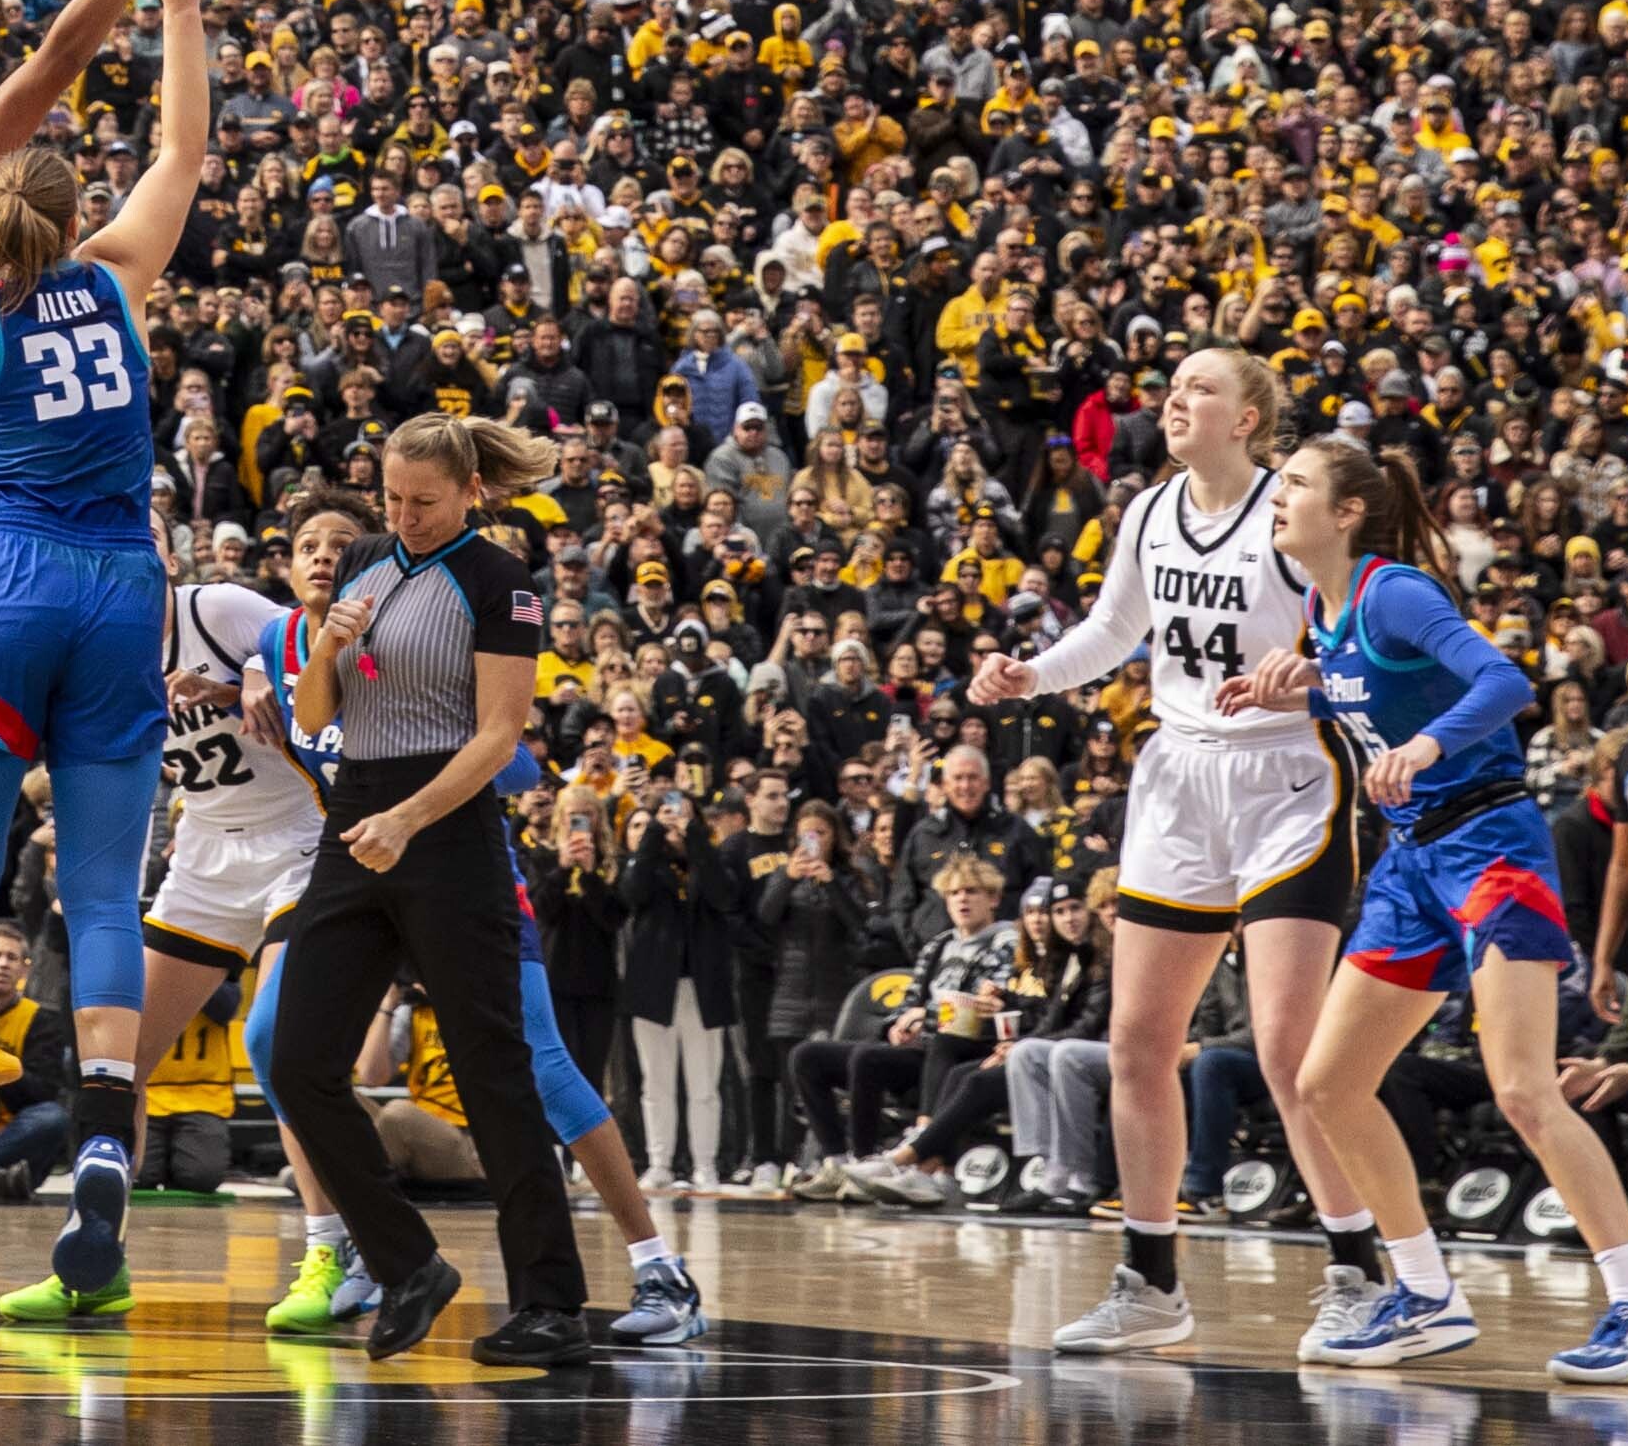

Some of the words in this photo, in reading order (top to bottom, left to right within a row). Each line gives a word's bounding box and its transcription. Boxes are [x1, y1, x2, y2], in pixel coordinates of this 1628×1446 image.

[37, 287, 97, 323] ALLEN
[21, 321, 132, 421] 33
[1153, 564, 1249, 613] IOWA
[1164, 614, 1245, 680] 44
[167, 703, 230, 737] WA
[162, 732, 256, 793] 22
